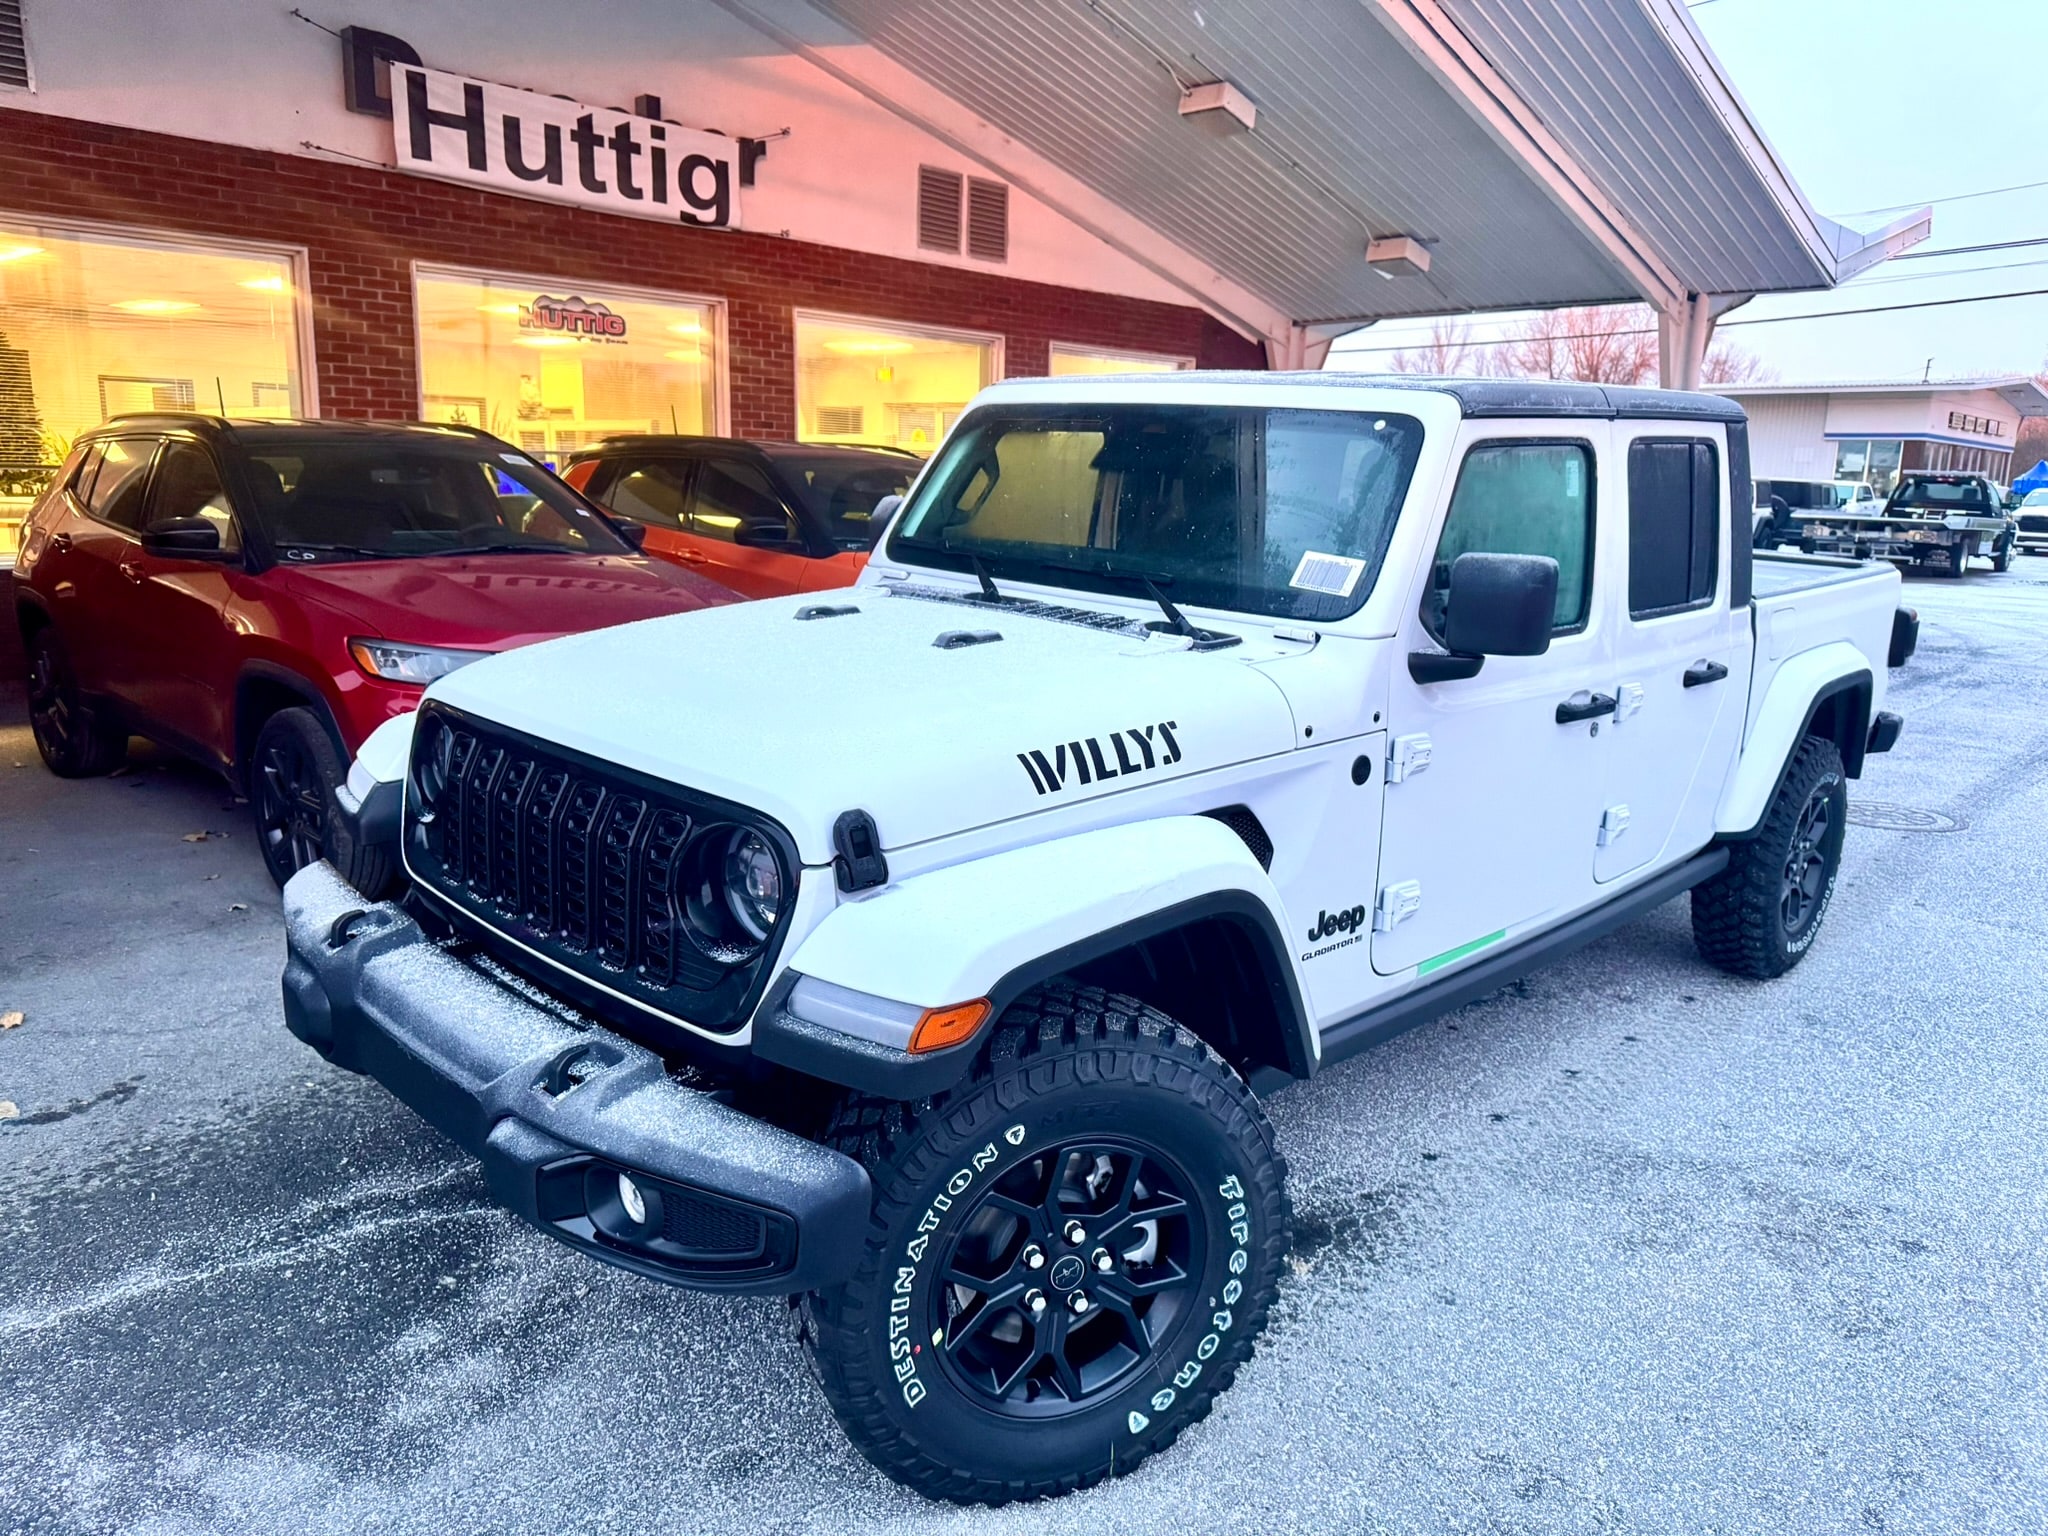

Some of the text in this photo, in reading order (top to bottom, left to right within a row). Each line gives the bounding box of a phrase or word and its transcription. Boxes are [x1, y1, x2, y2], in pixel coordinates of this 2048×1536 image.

[405, 69, 730, 227] Huttig
[519, 304, 626, 337] HUTTIG
[1016, 720, 1182, 795] WILLYS
[1301, 937, 1353, 961] GLADIATOR
[1308, 904, 1365, 942] Jeep
[889, 1142, 999, 1408] DESTINATION
[1150, 1174, 1250, 1412] Firestone
